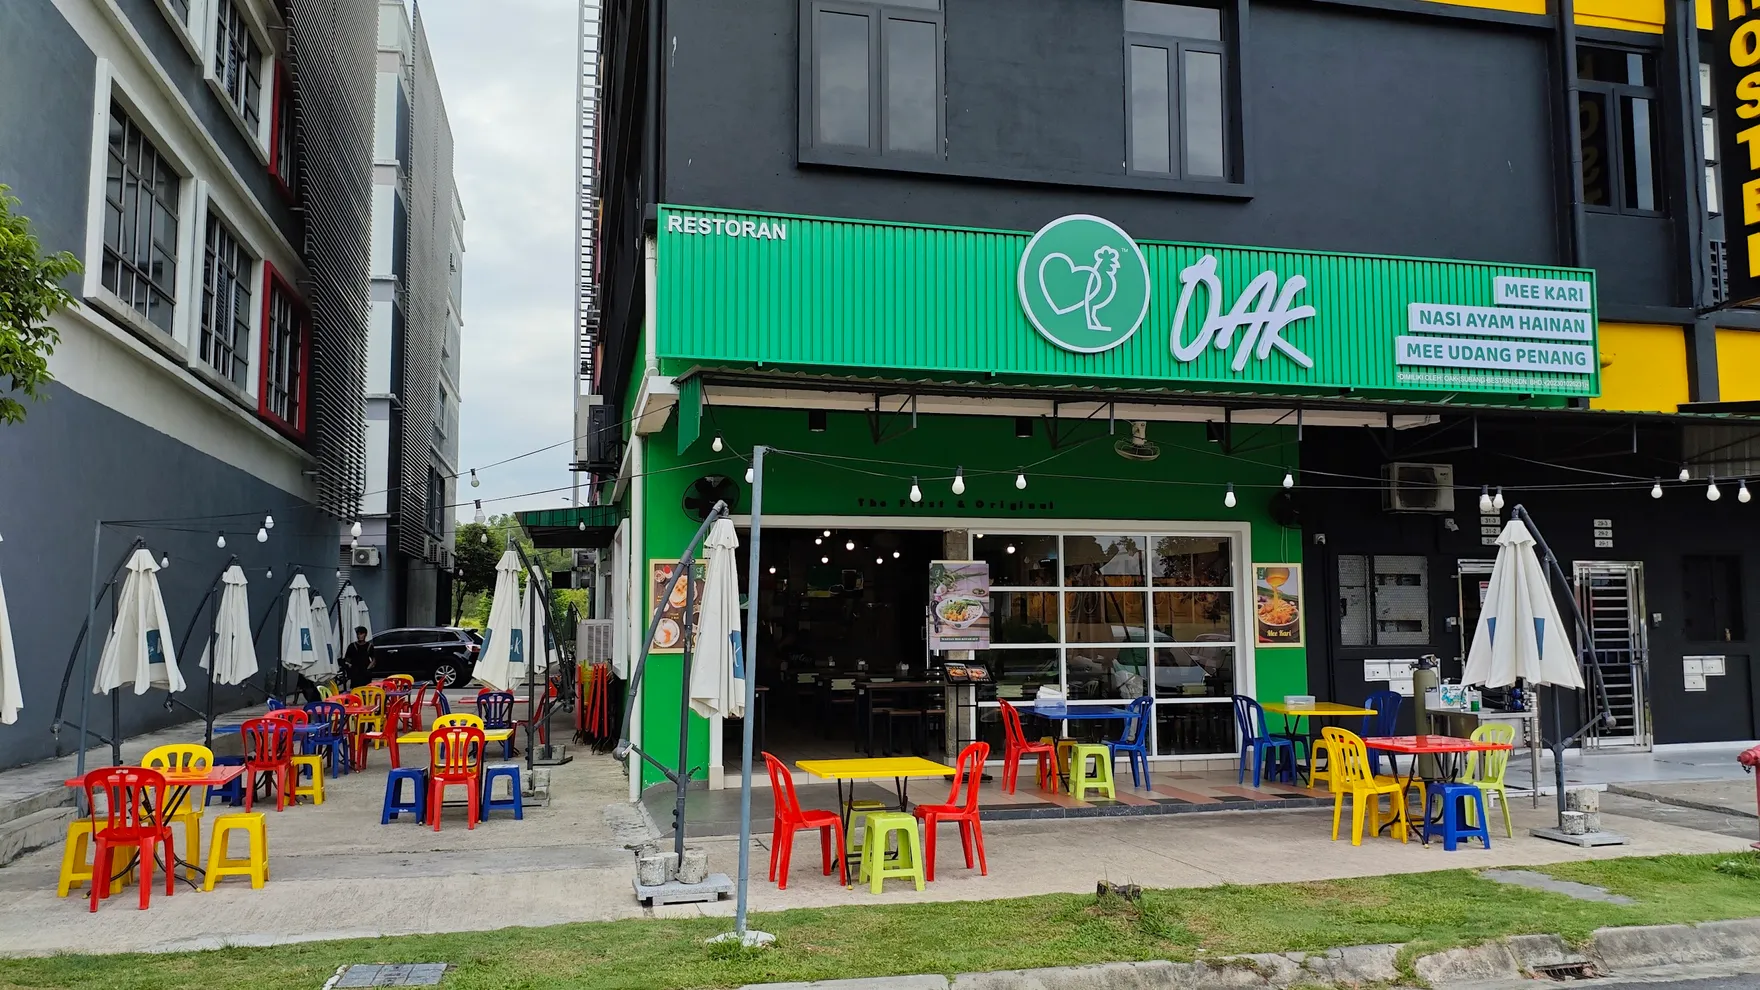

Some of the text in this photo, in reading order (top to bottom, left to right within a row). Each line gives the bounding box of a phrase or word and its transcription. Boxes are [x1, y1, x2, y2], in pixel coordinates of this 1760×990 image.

[1728, 0, 1760, 278] OSTE
[667, 215, 786, 241] RESTORAN
[1505, 283, 1584, 302] MEE KARI
[1170, 254, 1316, 372] OAK
[1419, 310, 1585, 334] NASI AYAM HAINAN
[1406, 343, 1586, 366] MEE UDANG PENANG
[858, 498, 887, 508] The
[957, 499, 965, 508] &
[976, 499, 1054, 511] Original
[1278, 629, 1292, 637] Kari
